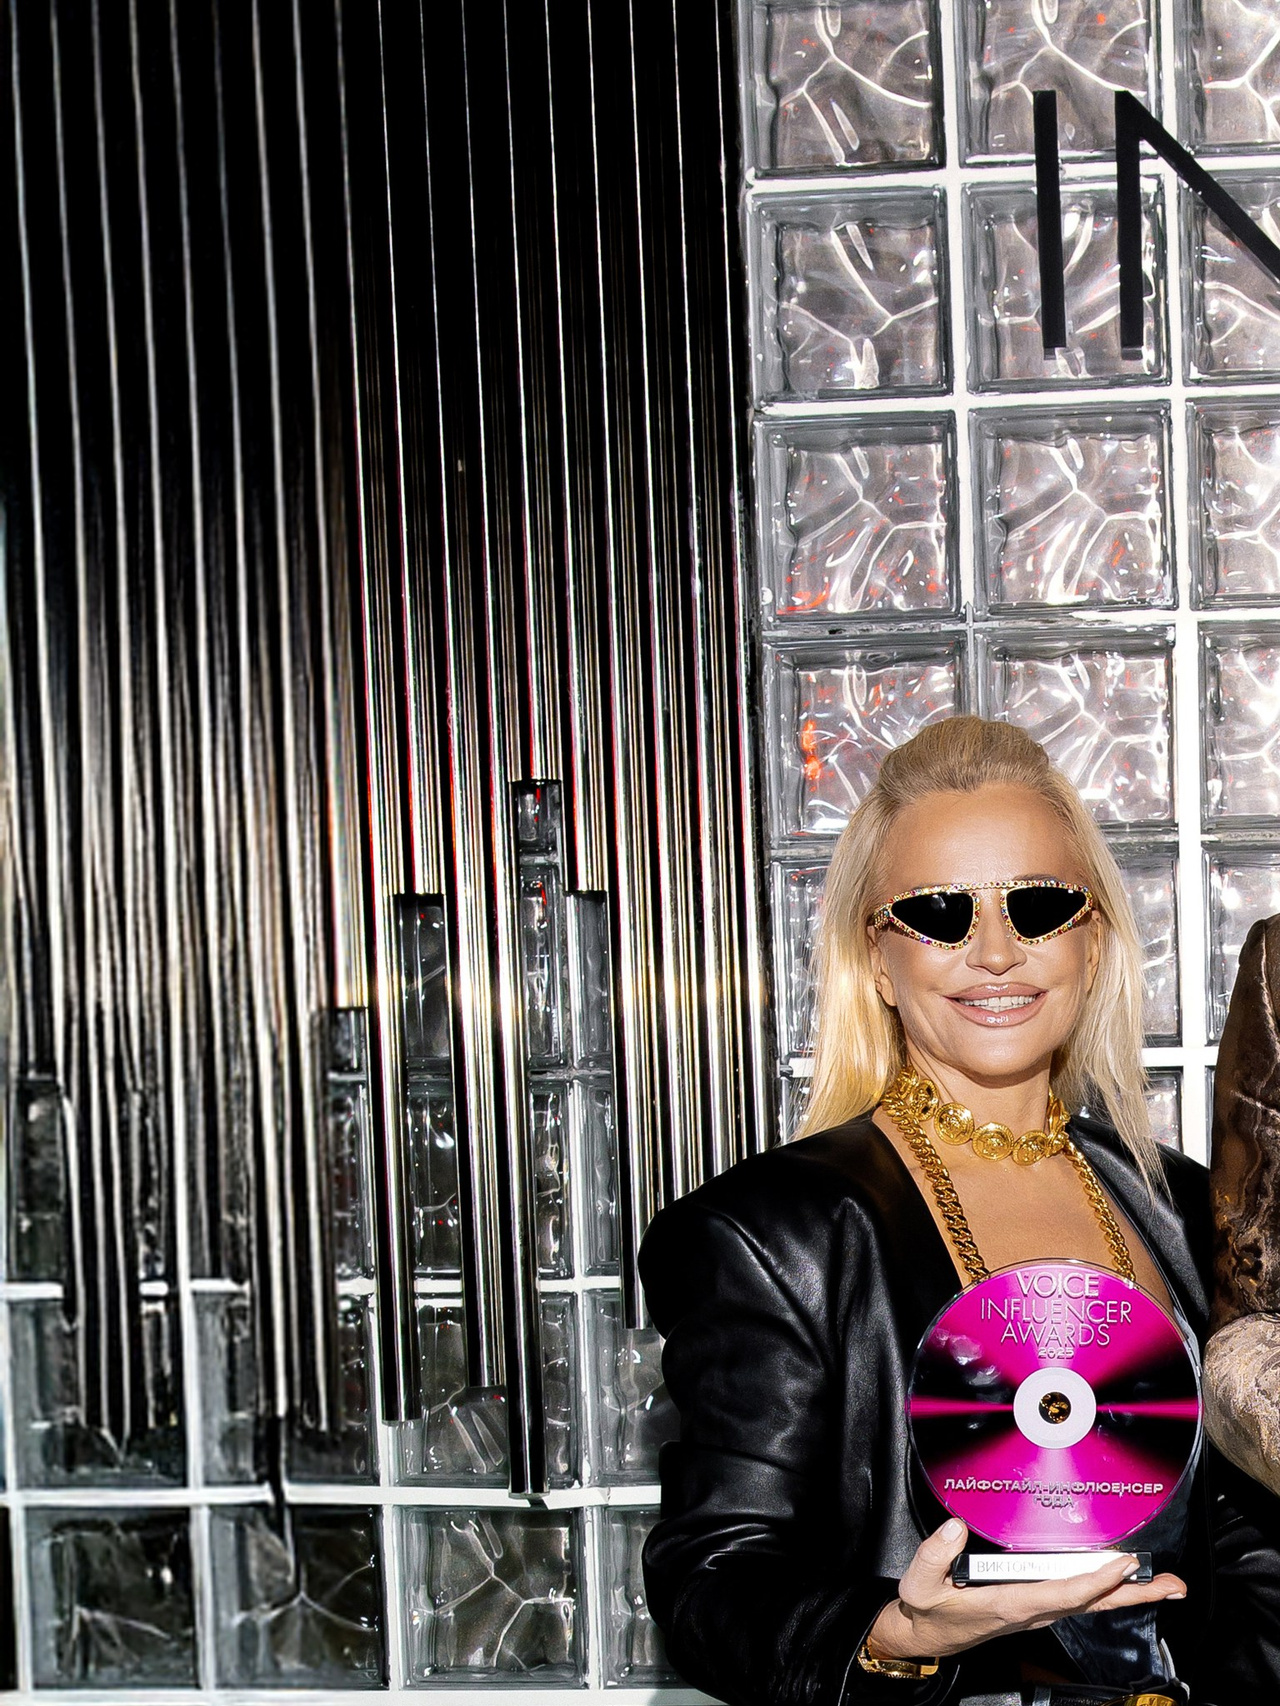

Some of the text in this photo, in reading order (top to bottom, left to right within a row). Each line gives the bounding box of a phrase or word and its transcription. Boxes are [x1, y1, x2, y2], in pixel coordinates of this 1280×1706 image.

[1015, 1271, 1100, 1299] VOICE
[980, 1297, 1132, 1324] INFLUENCER
[1000, 1321, 1111, 1348] AWARDS
[1038, 1346, 1075, 1360] 2025
[943, 1476, 1164, 1496] ЛАЙФСТАЙЛ-ИНФЛЮЕНСЕР
[1033, 1494, 1075, 1509] ГОДА
